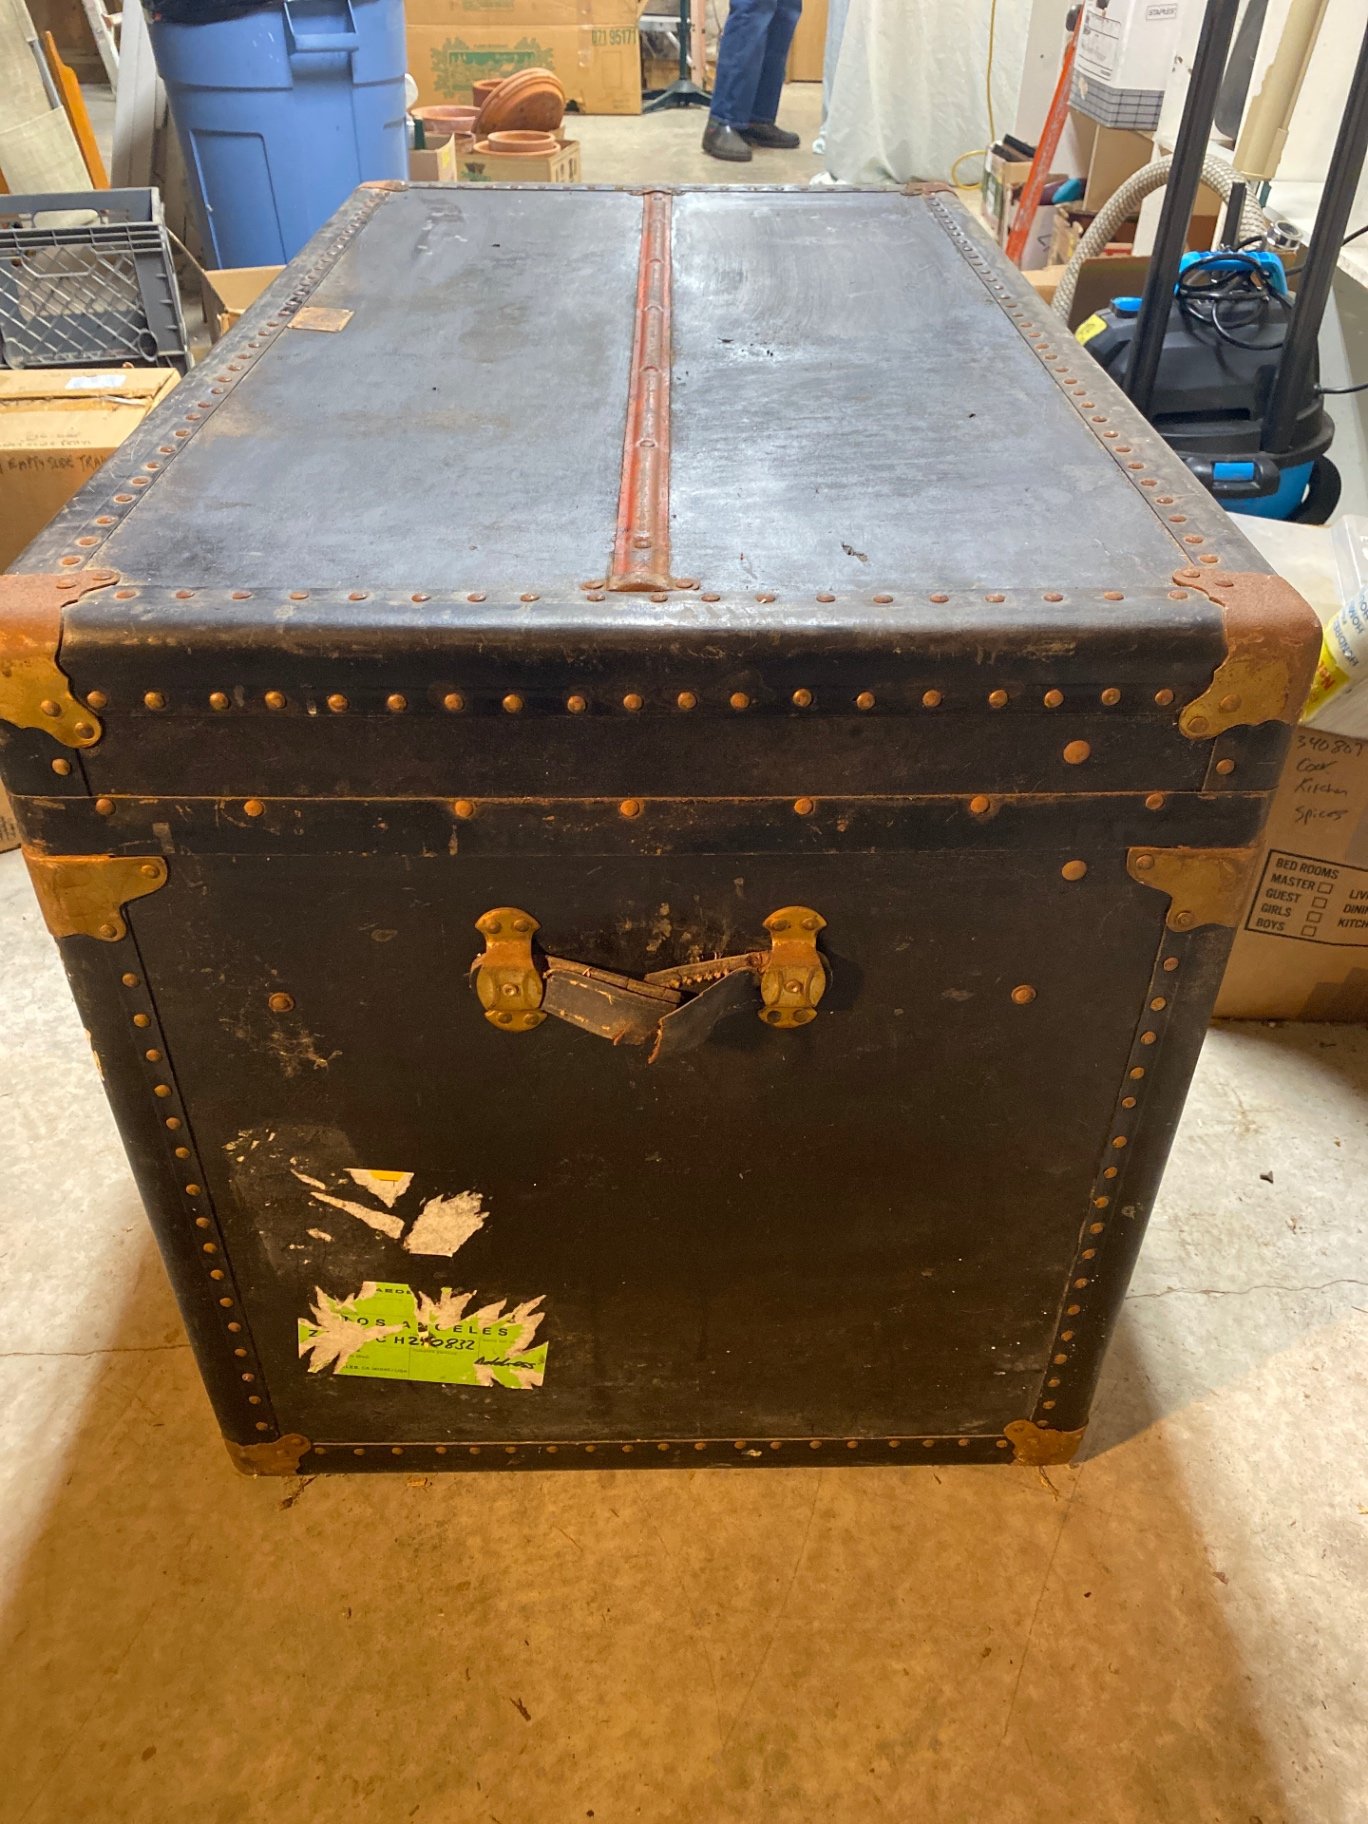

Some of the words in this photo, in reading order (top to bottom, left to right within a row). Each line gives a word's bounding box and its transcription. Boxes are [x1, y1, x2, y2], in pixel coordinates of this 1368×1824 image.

[1276, 857, 1298, 871] BED
[1300, 863, 1339, 880] ROOMS
[1271, 873, 1316, 891] MASTER
[1265, 888, 1302, 903] GUEST
[1261, 903, 1292, 918] GIRLS
[1256, 917, 1285, 932] BOYS
